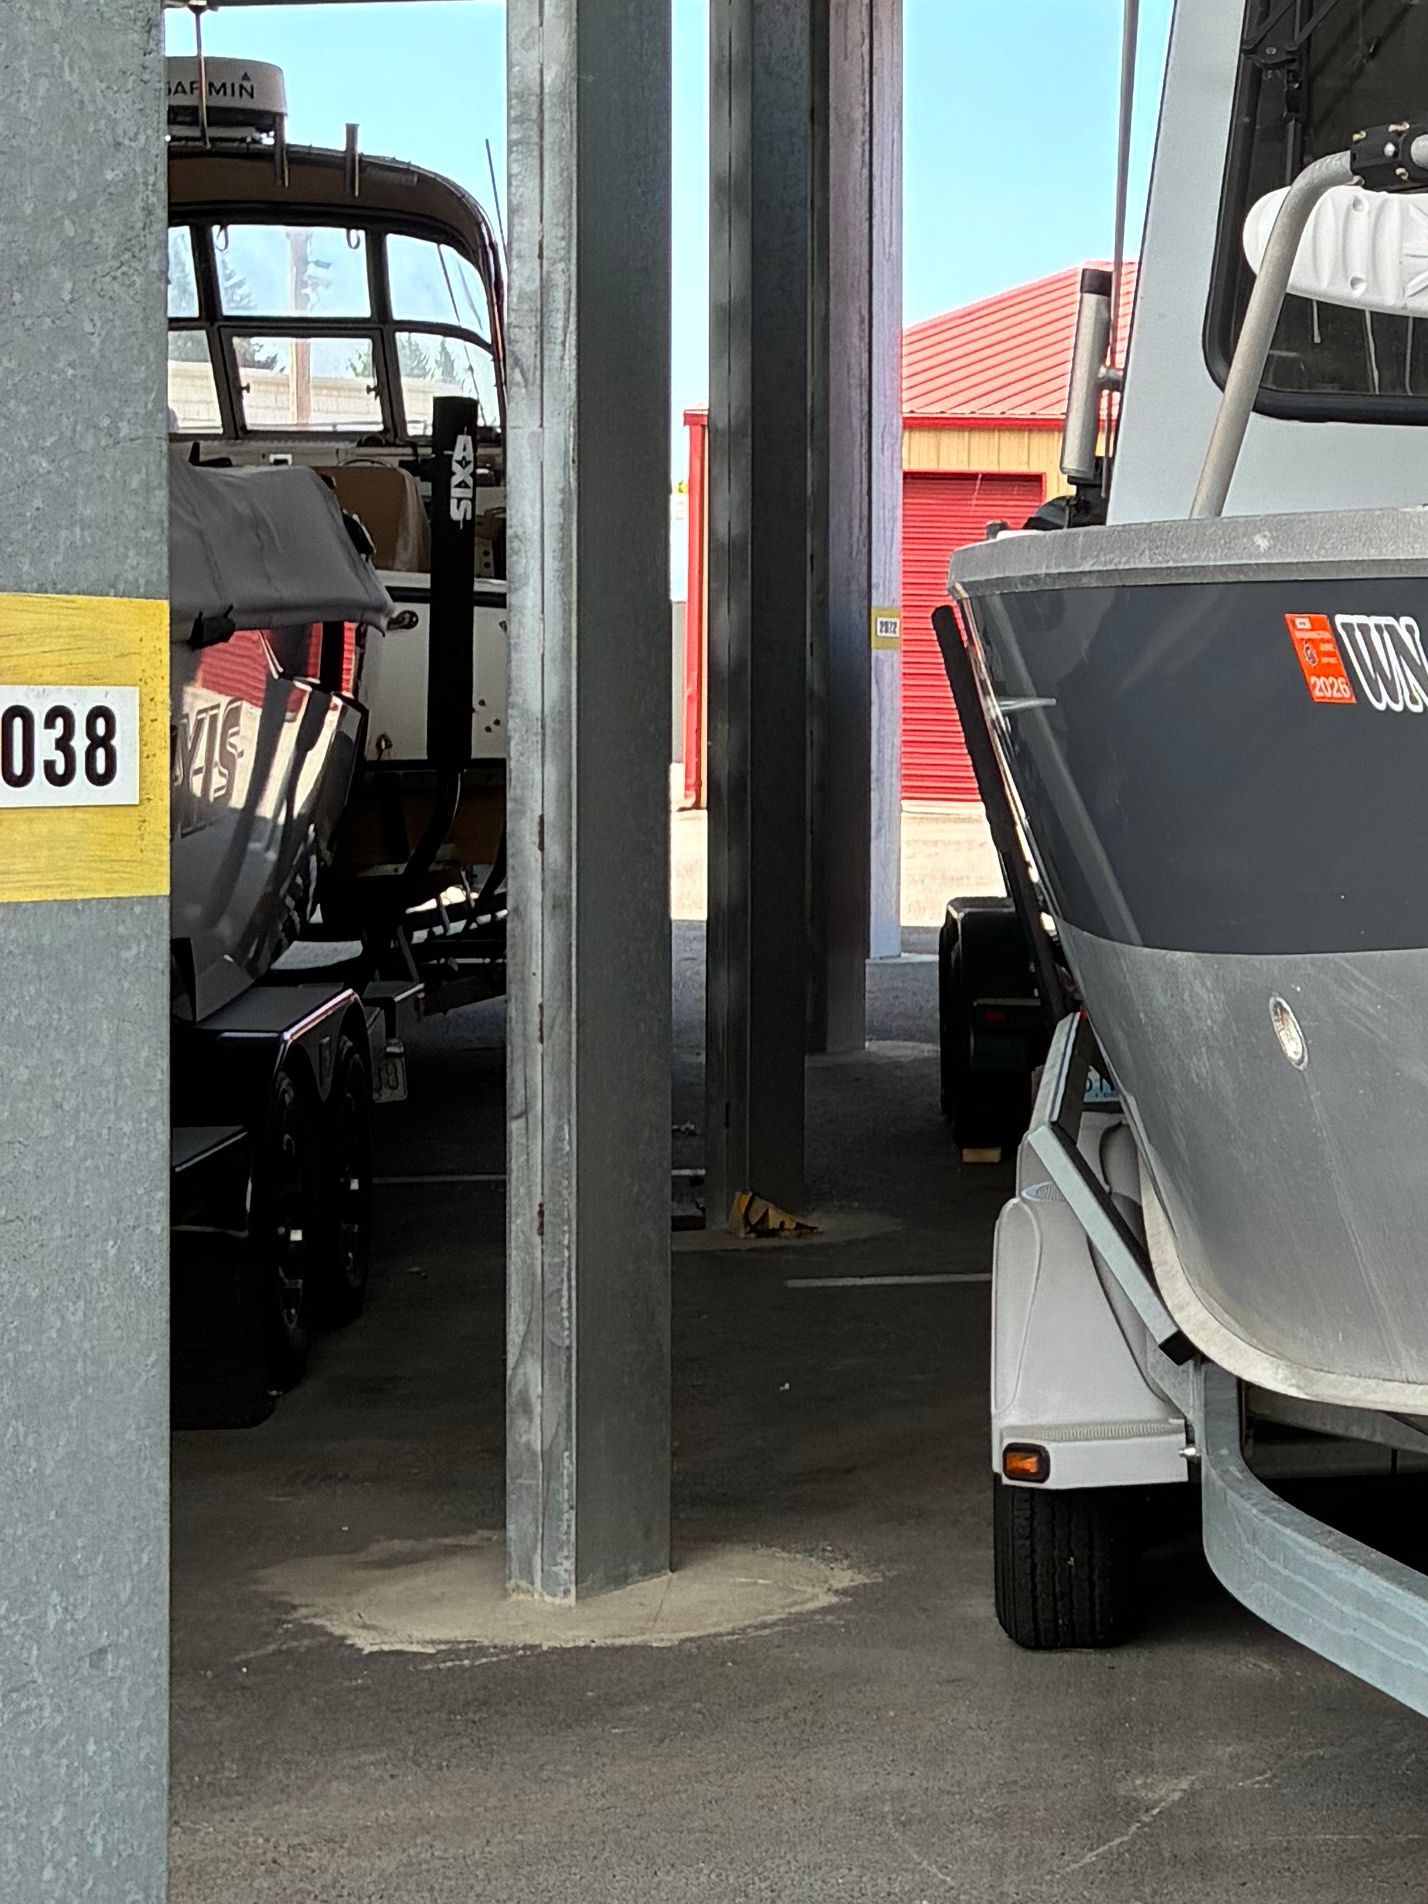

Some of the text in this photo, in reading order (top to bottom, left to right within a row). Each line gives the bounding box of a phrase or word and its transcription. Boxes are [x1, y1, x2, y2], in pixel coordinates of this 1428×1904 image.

[166, 80, 255, 100] ARMIN
[449, 428, 474, 528] AXIS
[1310, 675, 1351, 698] 2026
[1, 704, 118, 788] 038
